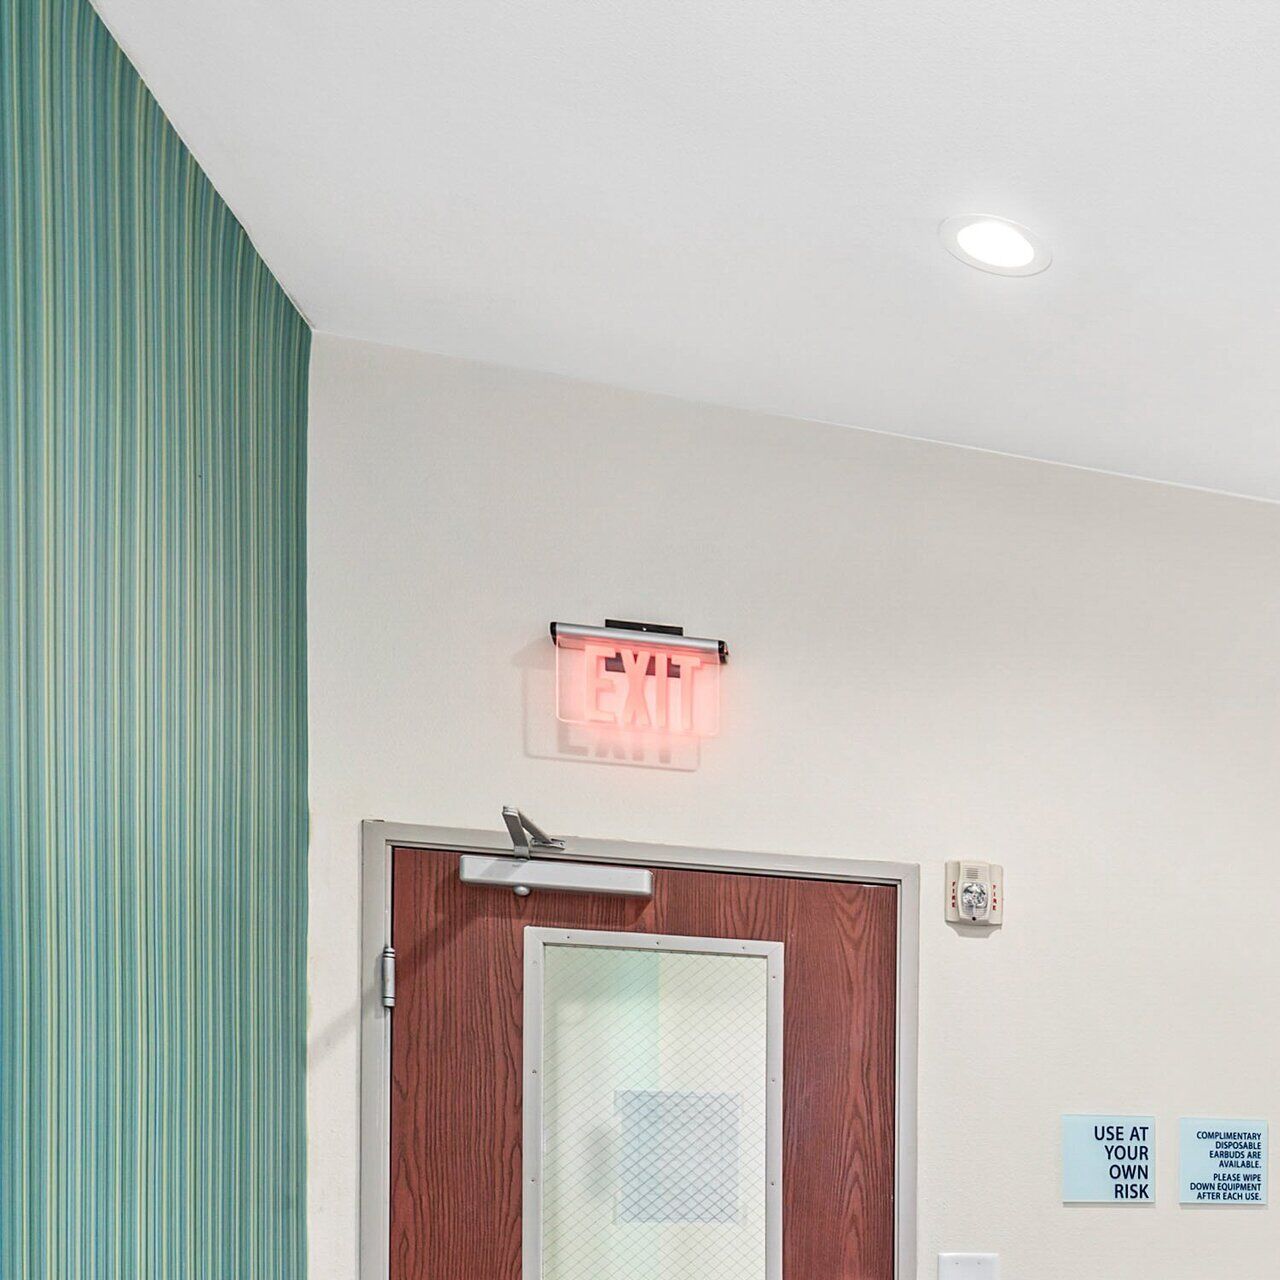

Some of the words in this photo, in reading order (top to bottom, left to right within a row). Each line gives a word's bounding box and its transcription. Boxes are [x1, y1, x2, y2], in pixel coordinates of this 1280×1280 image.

[584, 645, 700, 730] EXIT
[1094, 1126, 1124, 1141] USE
[1130, 1127, 1149, 1141] AT
[1196, 1131, 1261, 1140] COMPLIMENTARY
[1216, 1141, 1261, 1150] DISPOSABLE
[1105, 1145, 1148, 1160] YOUR
[1209, 1151, 1245, 1159] EARBUDS
[1247, 1151, 1261, 1159] ARE
[1219, 1160, 1261, 1168] AVAILABLE.
[1109, 1165, 1148, 1180] OWN
[1115, 1184, 1149, 1198] RISK
[1190, 1183, 1216, 1191] DOWN
[1218, 1183, 1261, 1191] EQUIPMENT
[1197, 1192, 1221, 1200] AFTER
[1223, 1192, 1243, 1200] EACH
